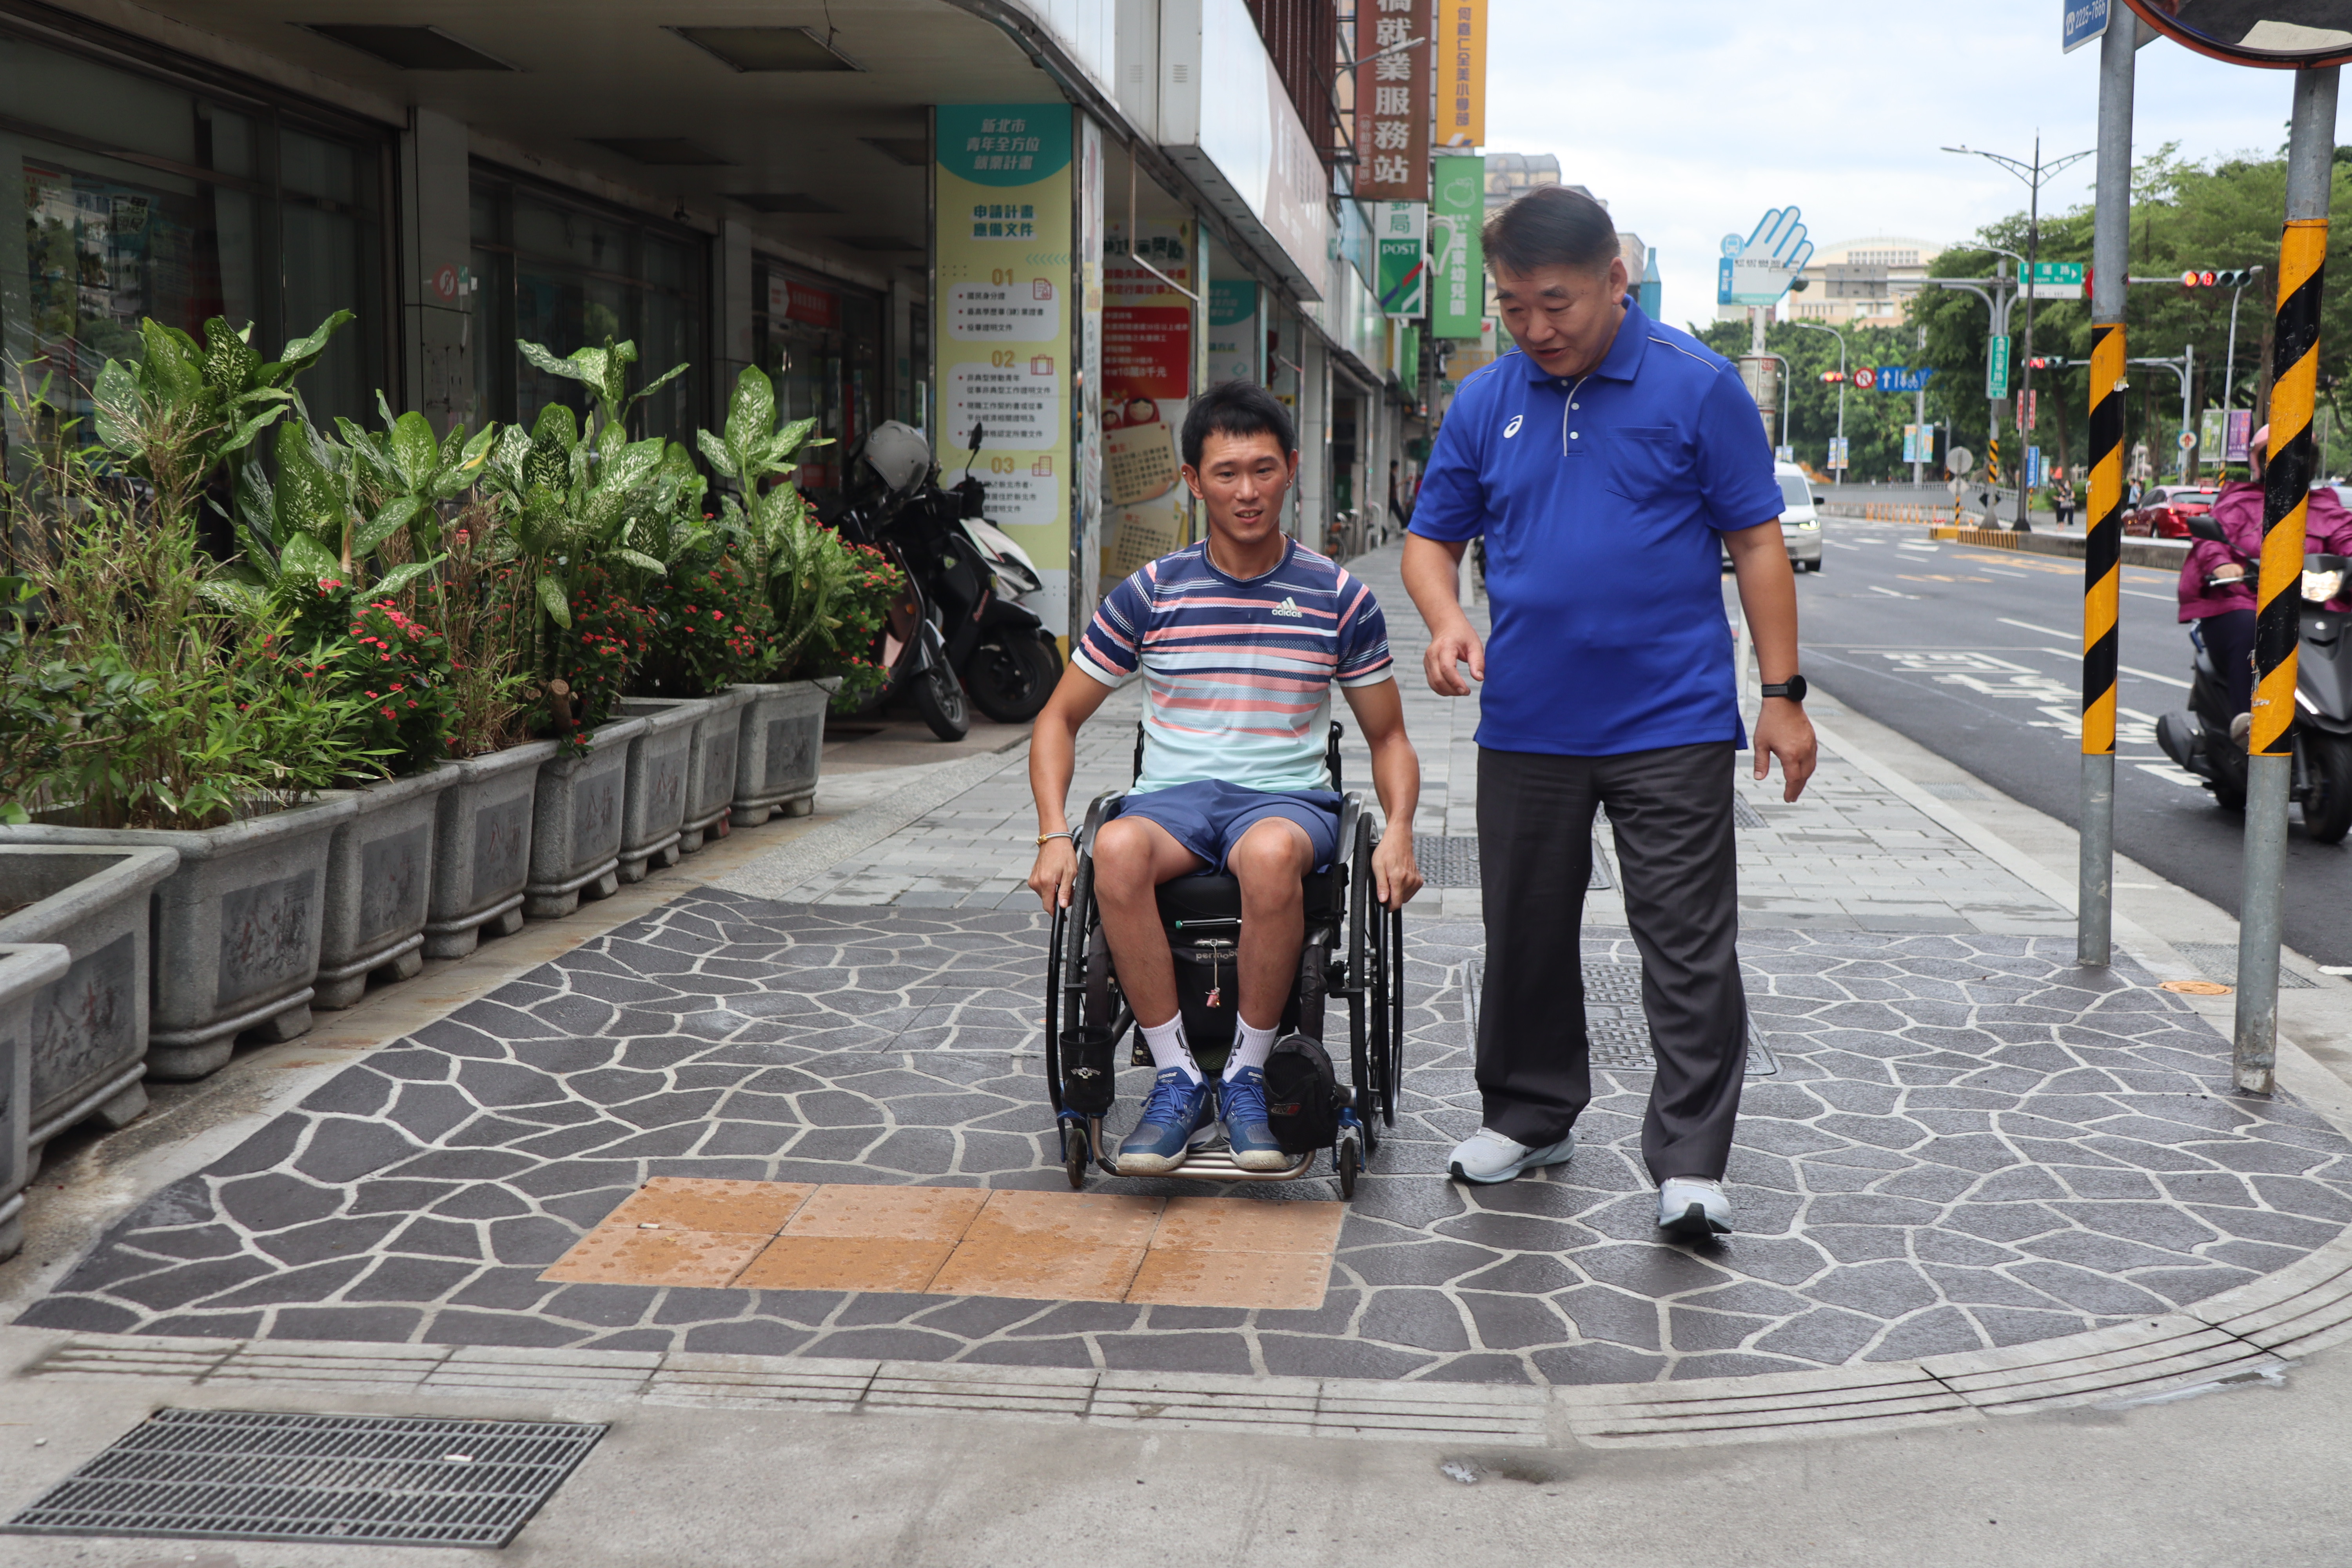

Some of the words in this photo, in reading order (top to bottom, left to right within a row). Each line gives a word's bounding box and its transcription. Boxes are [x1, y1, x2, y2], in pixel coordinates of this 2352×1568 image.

[981, 118, 1026, 133] 新北市
[966, 136, 1040, 151] 青年全方位
[974, 204, 1033, 218] 申請計畫
[1382, 243, 1416, 255] POST
[992, 268, 1013, 287] 01
[991, 350, 1015, 368] 02
[991, 457, 1014, 474] 03
[1272, 608, 1302, 618] adidas
